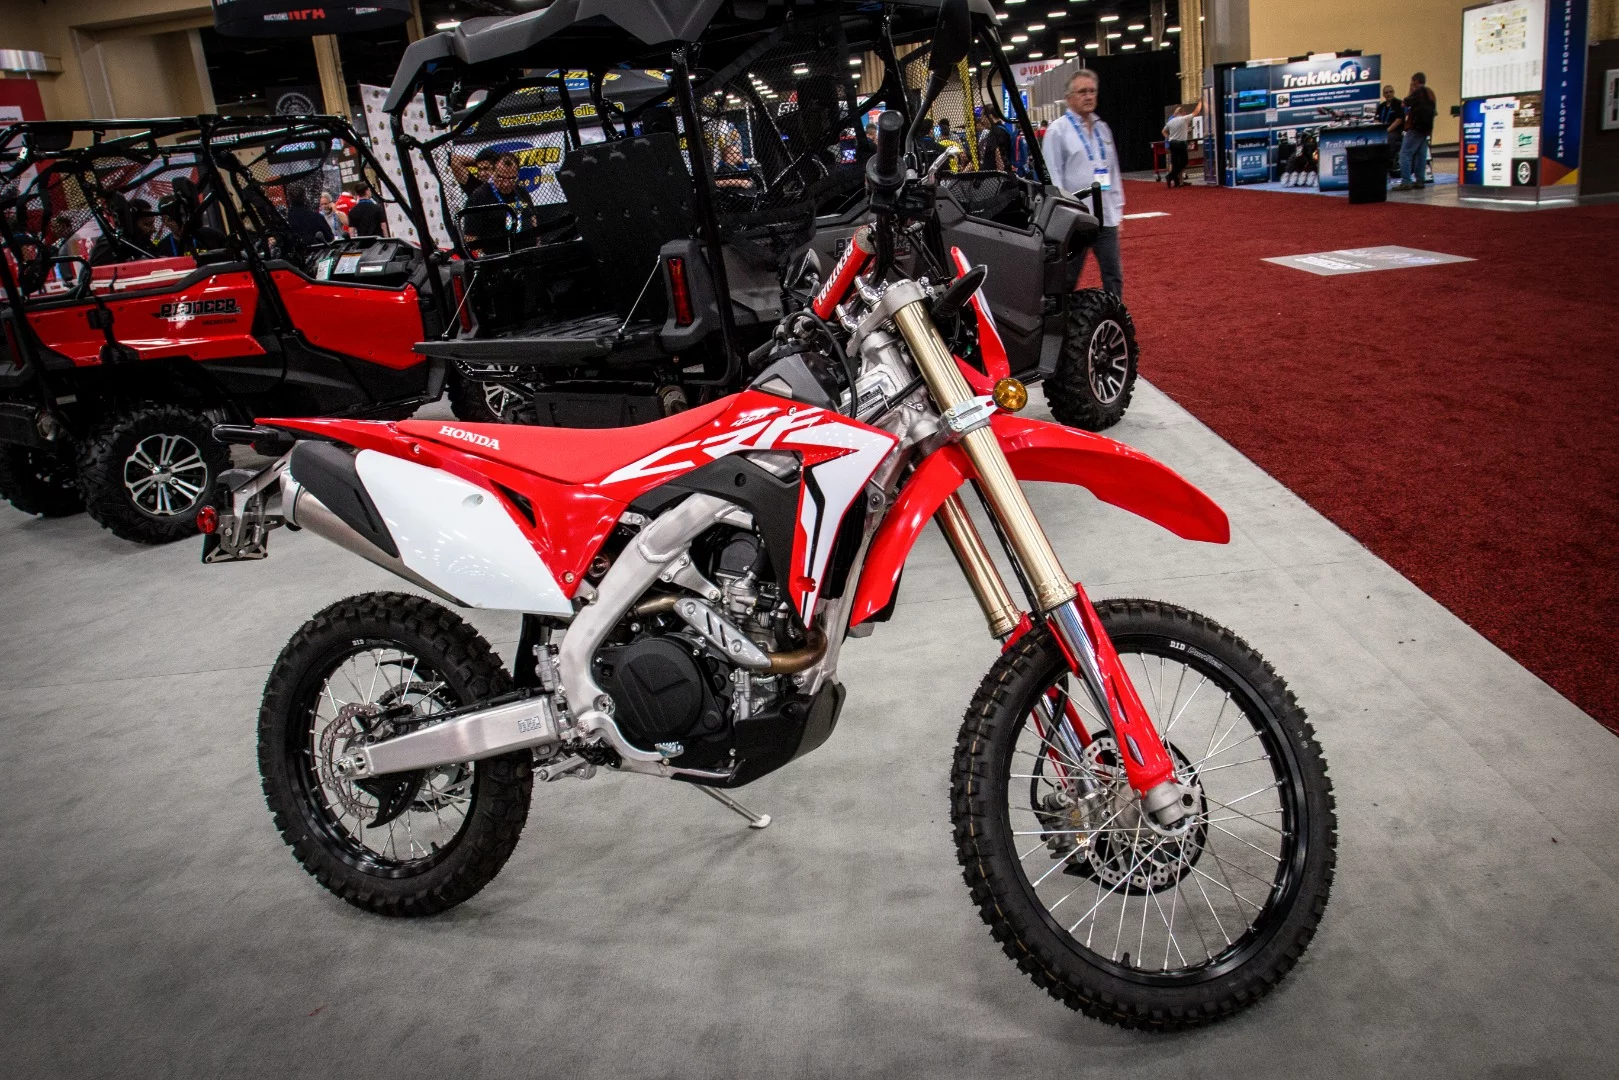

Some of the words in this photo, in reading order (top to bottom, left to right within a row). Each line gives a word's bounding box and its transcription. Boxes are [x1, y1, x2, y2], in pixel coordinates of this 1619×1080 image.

[1028, 64, 1056, 75] YAMA
[1557, 94, 1567, 158] FLOORPLAN
[438, 425, 500, 451] HONDA
